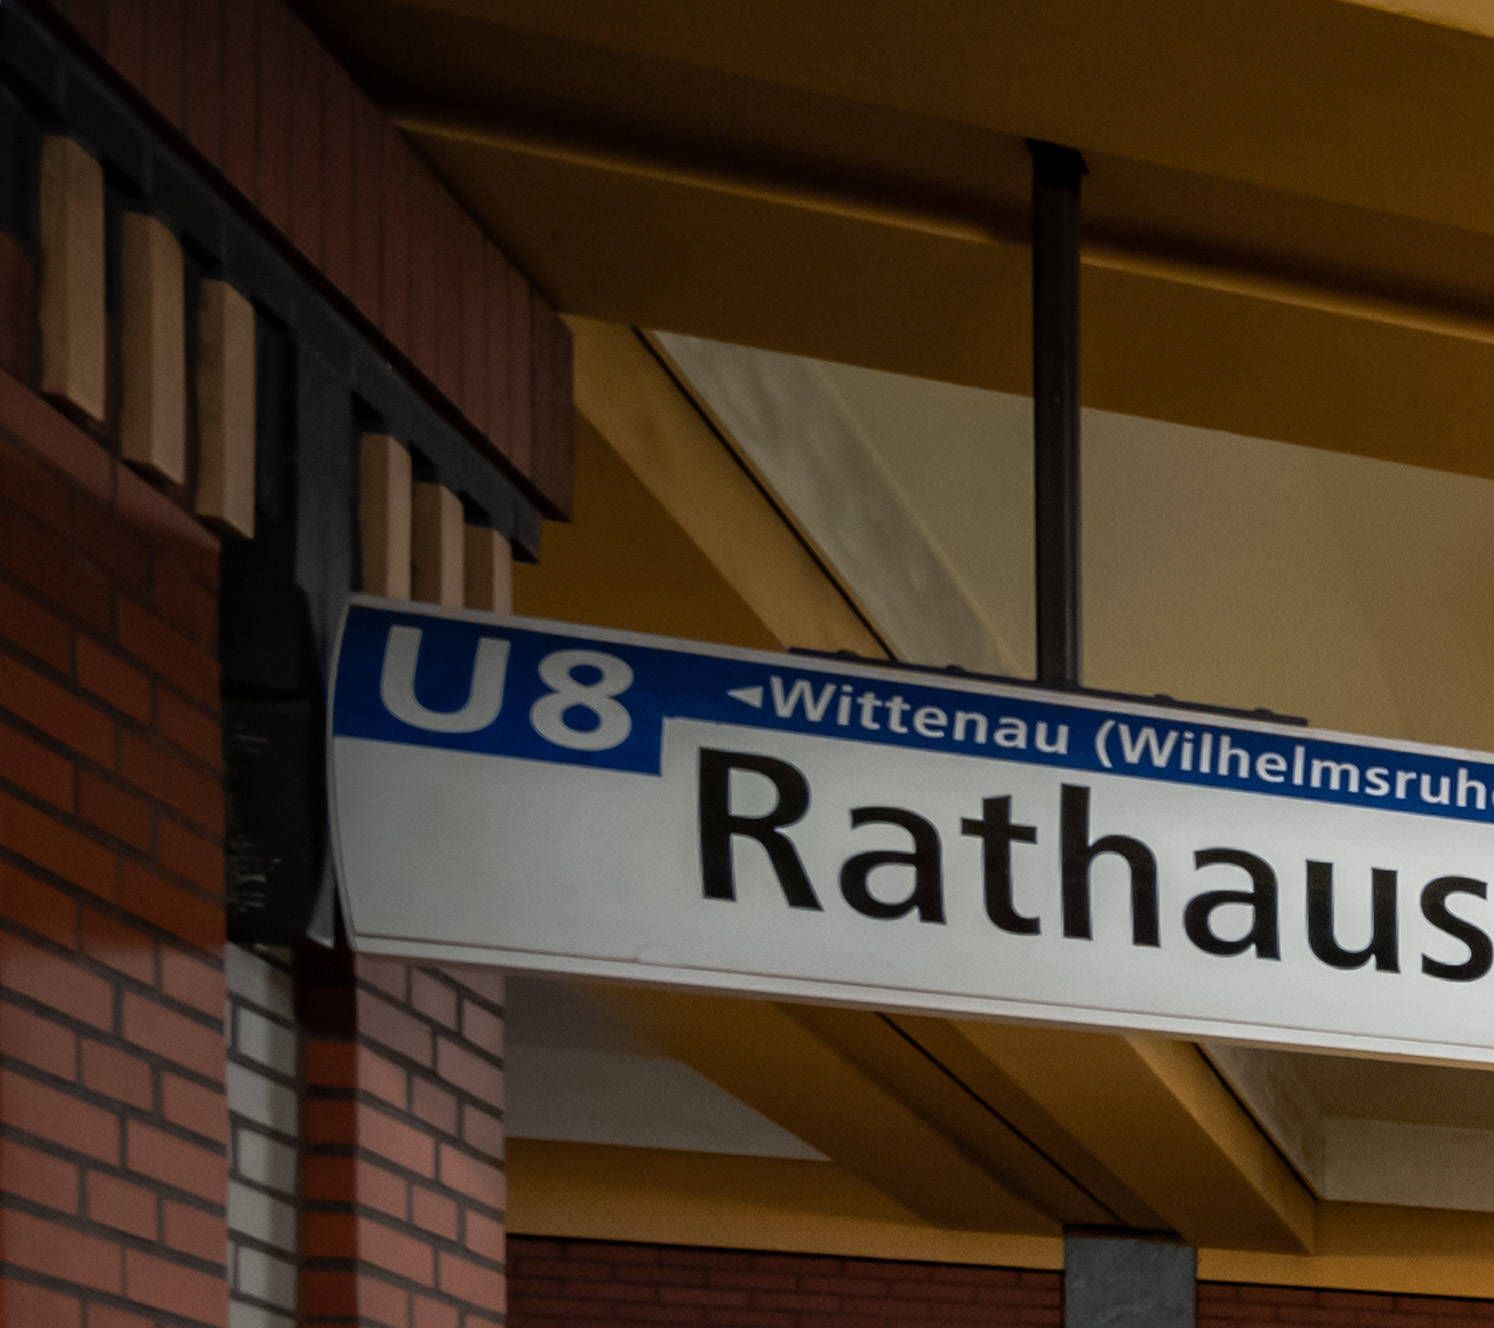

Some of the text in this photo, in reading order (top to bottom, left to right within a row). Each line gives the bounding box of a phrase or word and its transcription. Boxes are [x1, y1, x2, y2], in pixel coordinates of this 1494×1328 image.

[380, 625, 635, 752] U8
[769, 675, 1069, 755] Wittenau
[697, 744, 1494, 983] Rathaus
